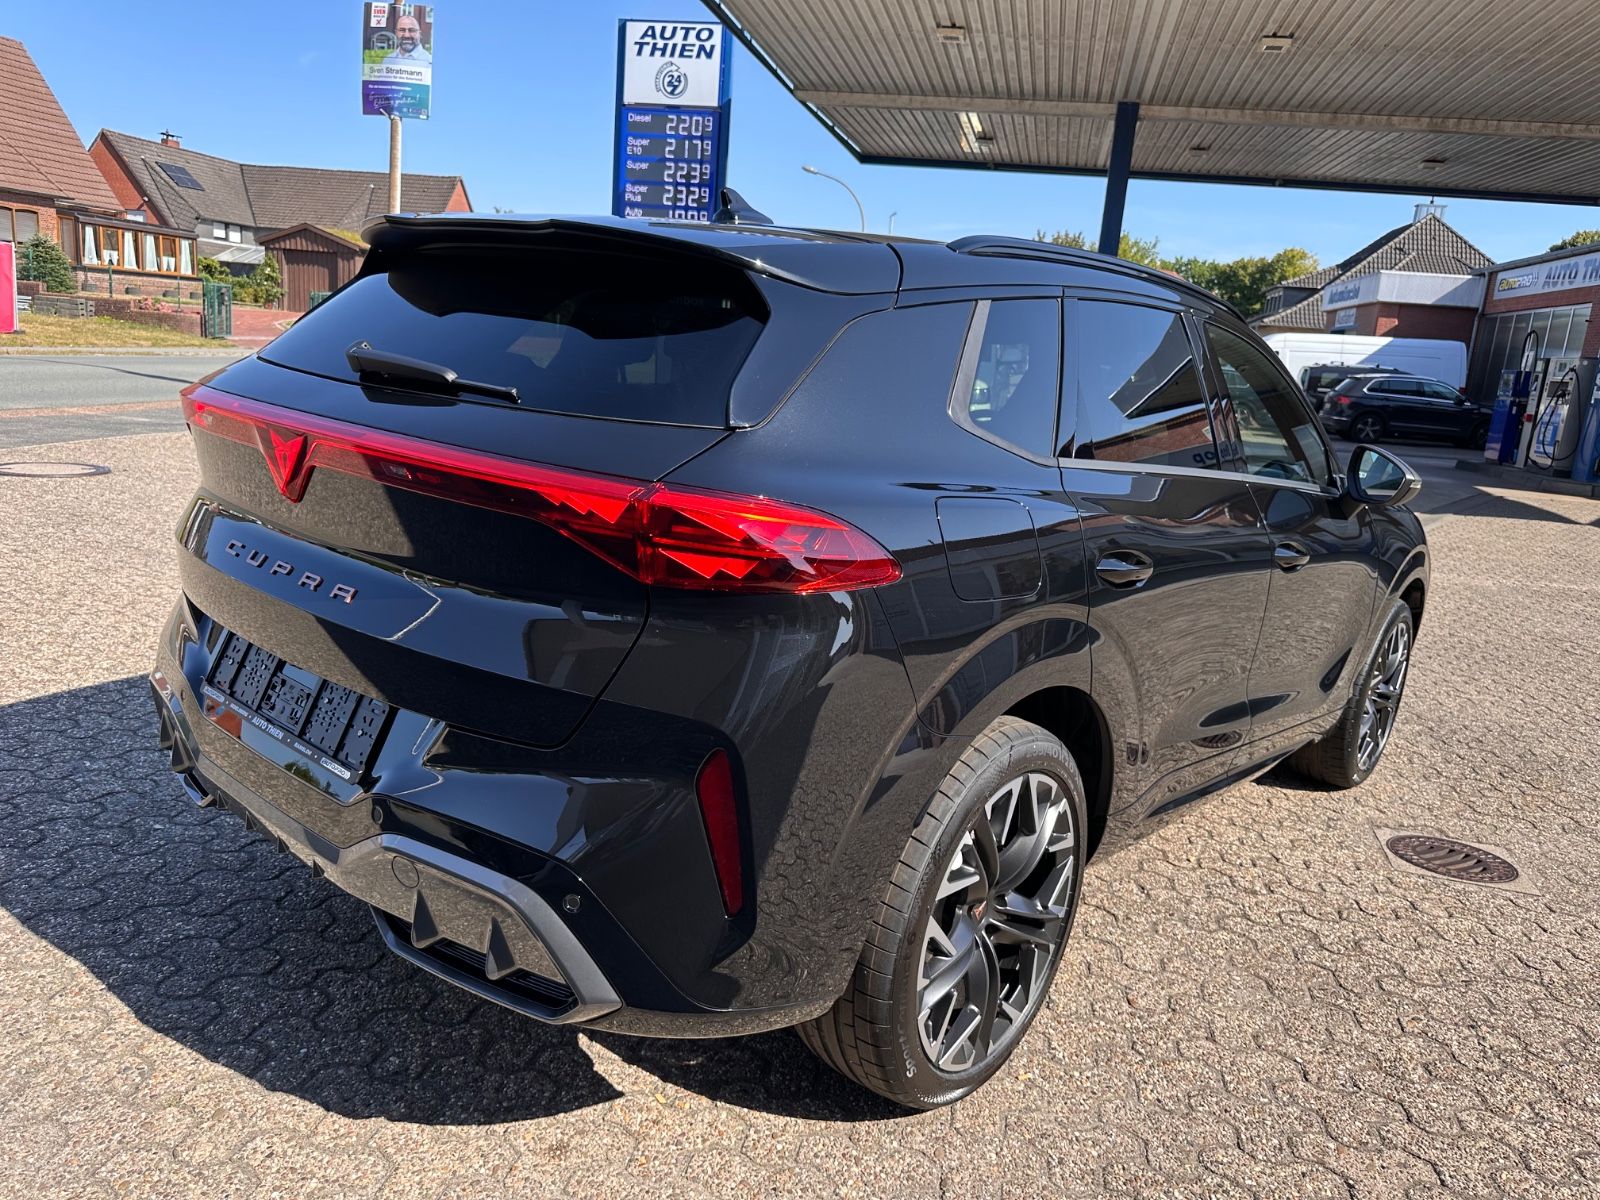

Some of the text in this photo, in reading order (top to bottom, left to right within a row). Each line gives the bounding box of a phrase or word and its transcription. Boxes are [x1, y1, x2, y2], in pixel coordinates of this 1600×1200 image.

[640, 25, 714, 42] AUTO
[634, 42, 715, 59] THIEN
[385, 67, 422, 77] Stratmann
[667, 74, 682, 87] 24
[628, 113, 652, 122] Diesel
[627, 137, 650, 148] Super
[627, 147, 642, 155] E10
[626, 160, 649, 170] Super
[625, 183, 648, 194] Super
[625, 194, 642, 202] Plus
[624, 206, 643, 217] Auto
[1542, 261, 1580, 289] AUTO
[1582, 257, 1600, 283] TH
[225, 539, 358, 604] CUPRA
[252, 716, 268, 730] AUTO
[266, 724, 285, 740] THIEN
